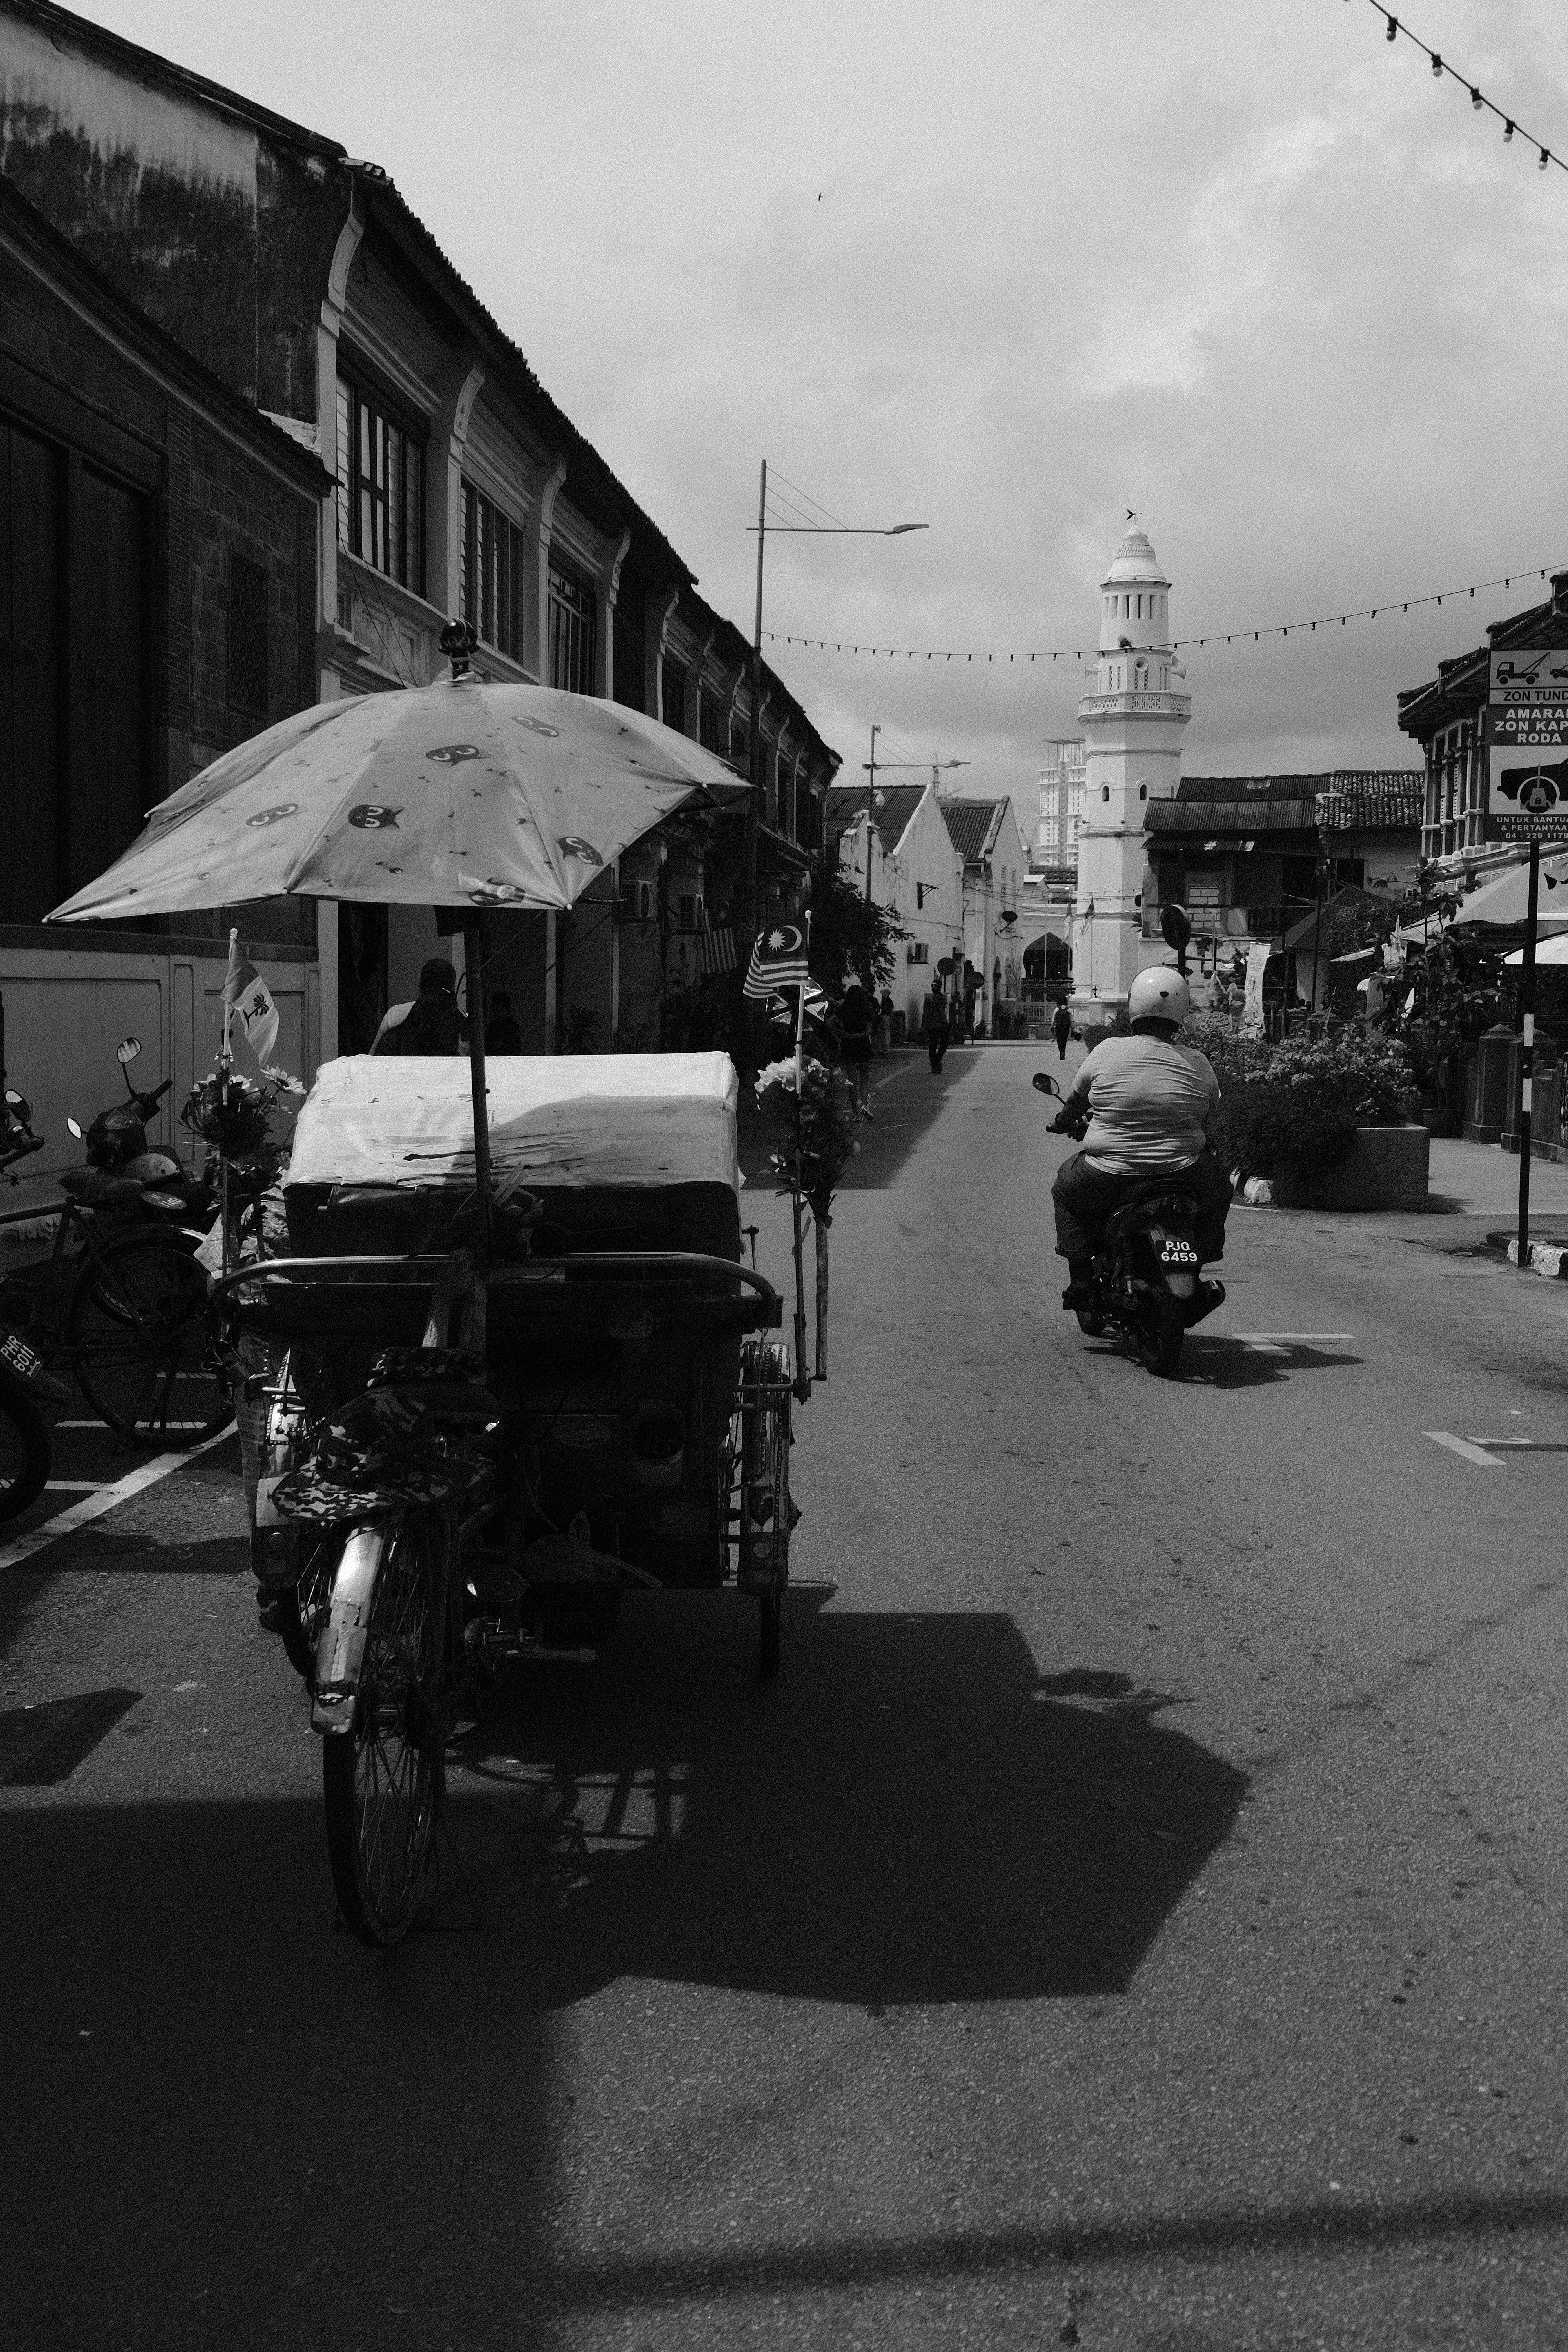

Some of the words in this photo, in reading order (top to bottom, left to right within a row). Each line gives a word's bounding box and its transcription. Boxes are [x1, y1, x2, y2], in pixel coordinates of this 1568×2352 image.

[1503, 691, 1530, 701] ZON
[1506, 708, 1568, 719] AMARA
[1494, 720, 1528, 731] ZON
[1535, 720, 1568, 731] KAP
[1517, 733, 1562, 743] RODA
[1166, 1241, 1190, 1251] PJQ
[1161, 1252, 1198, 1262] 6459
[0, 1335, 22, 1360] PHR
[13, 1345, 35, 1372] 6011
